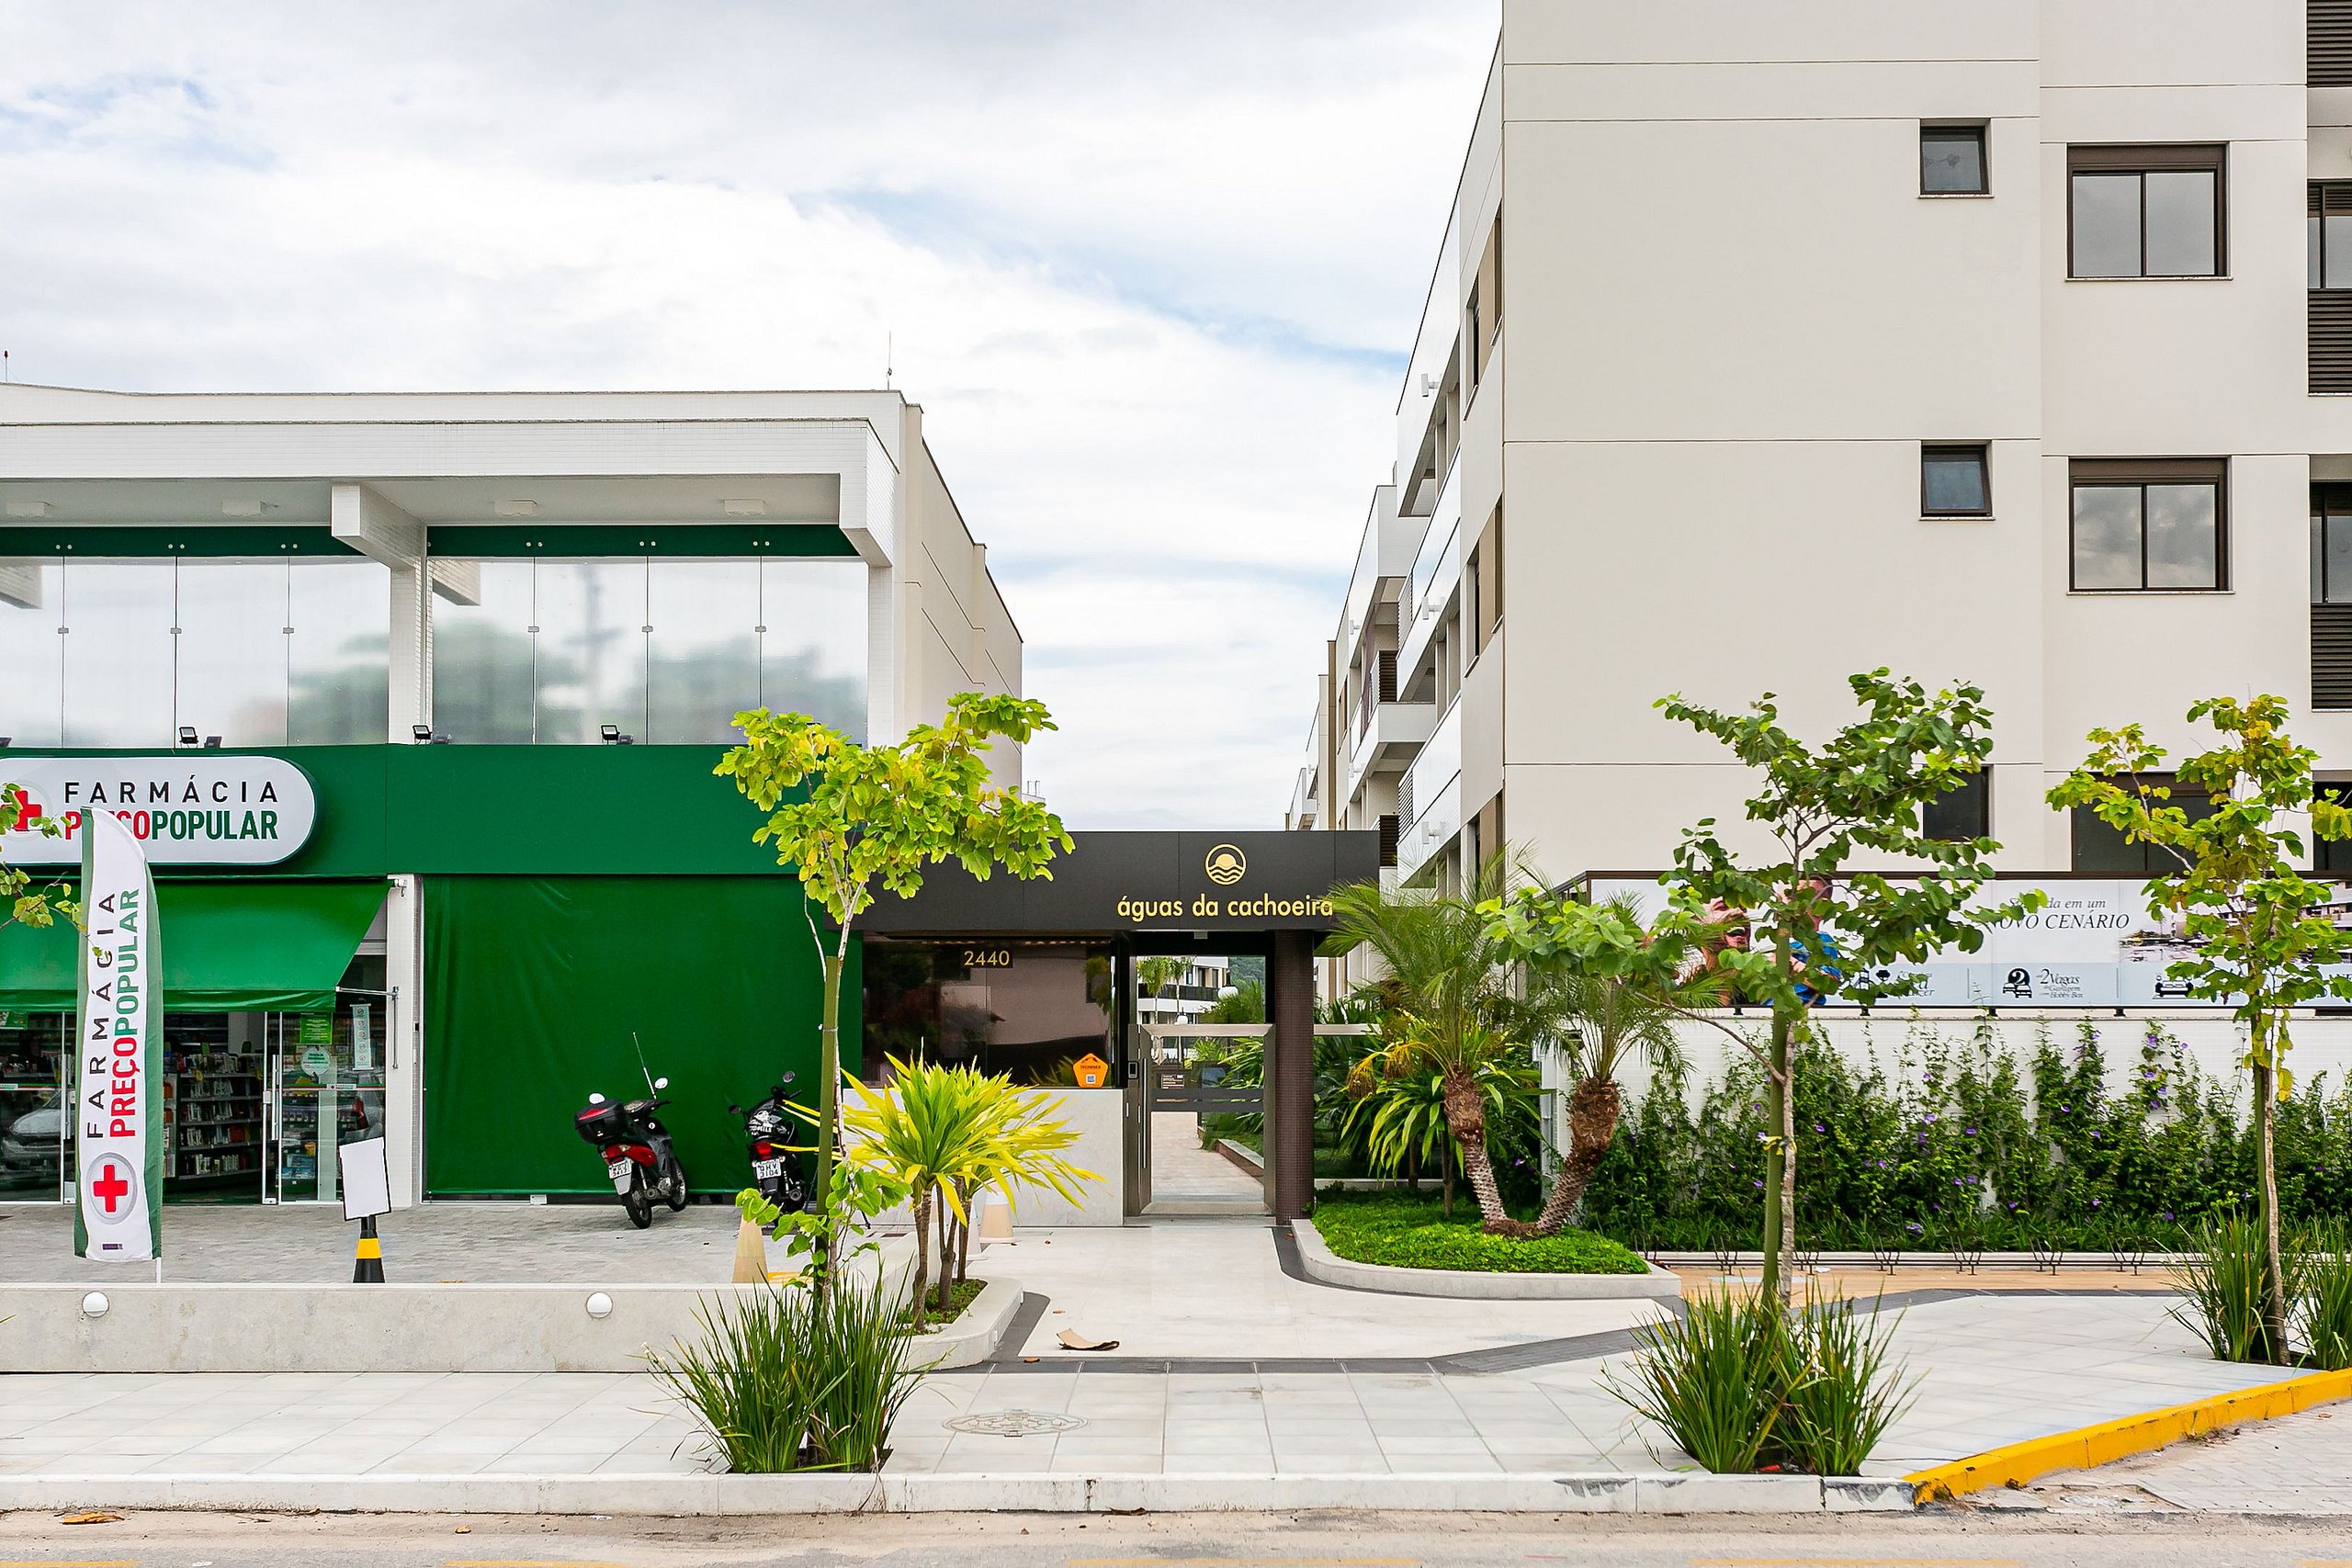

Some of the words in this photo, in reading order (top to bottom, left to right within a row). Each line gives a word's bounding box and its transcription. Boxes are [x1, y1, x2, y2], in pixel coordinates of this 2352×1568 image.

[64, 774, 278, 804] FARMÁCIA
[65, 810, 278, 840] POPOPULAR
[1117, 896, 1183, 922] águas
[1193, 893, 1219, 917] da
[1227, 892, 1333, 917] cachoeira
[2064, 900, 2086, 908] em
[2087, 900, 2106, 908] um
[2045, 909, 2130, 930] CENÁRIO
[964, 950, 1010, 966] 2440
[2013, 971, 2025, 985] 2
[86, 893, 115, 1138] FARMÁCIA
[109, 888, 140, 1138] PREÇOPOPULAR
